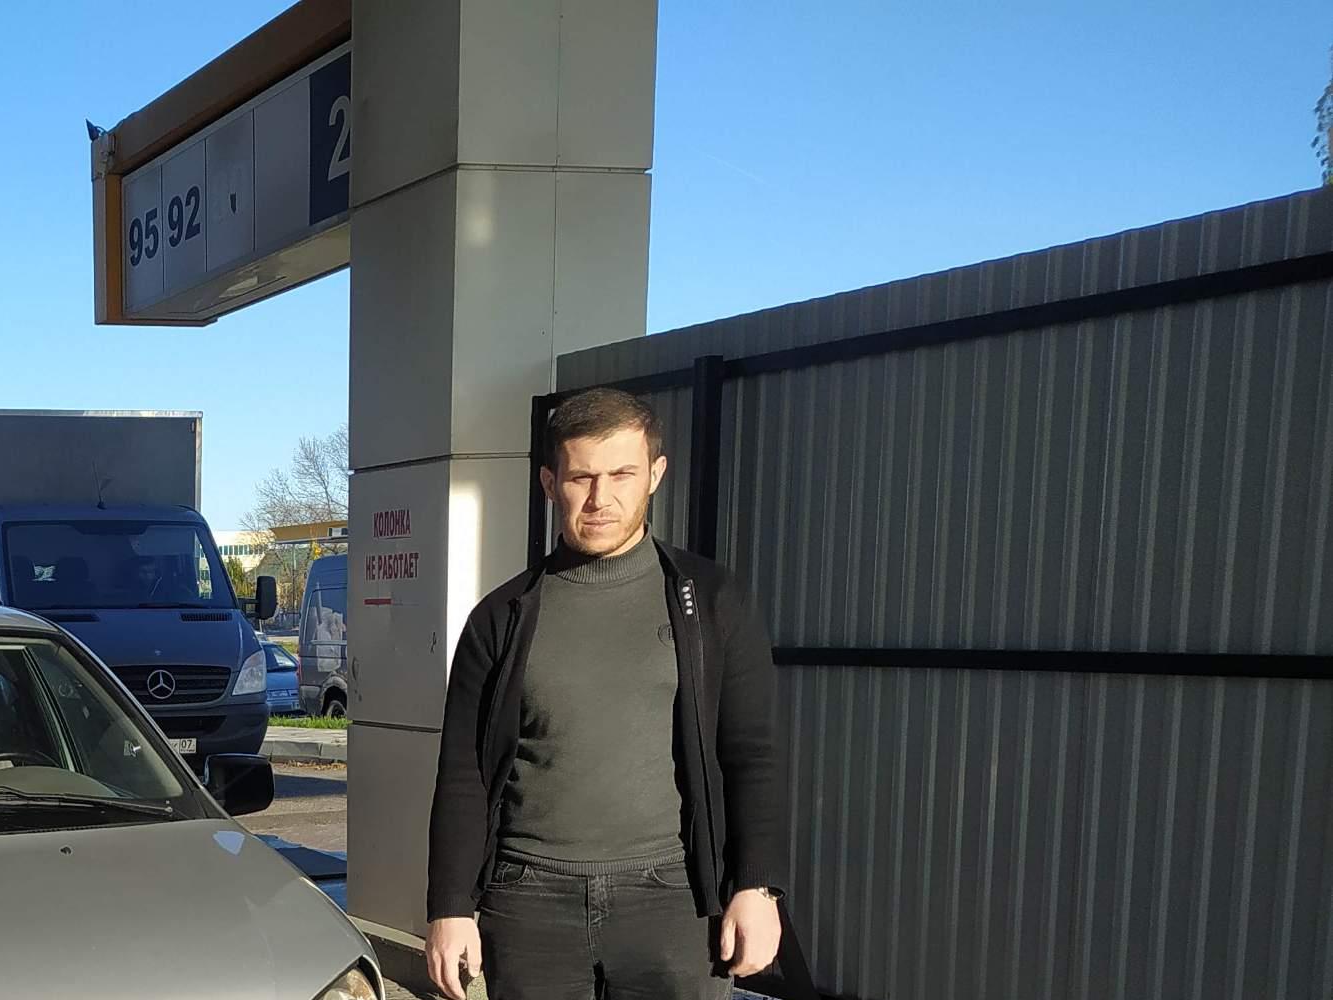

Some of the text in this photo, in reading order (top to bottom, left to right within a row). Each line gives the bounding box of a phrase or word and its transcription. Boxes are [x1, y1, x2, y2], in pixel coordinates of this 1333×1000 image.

[328, 95, 351, 182] 2
[129, 207, 159, 267] 95
[167, 185, 201, 248] 92
[373, 510, 411, 537] КОЛОНКА
[365, 552, 419, 580] НЕ РАБОТАЕТ
[181, 740, 192, 749] 07
